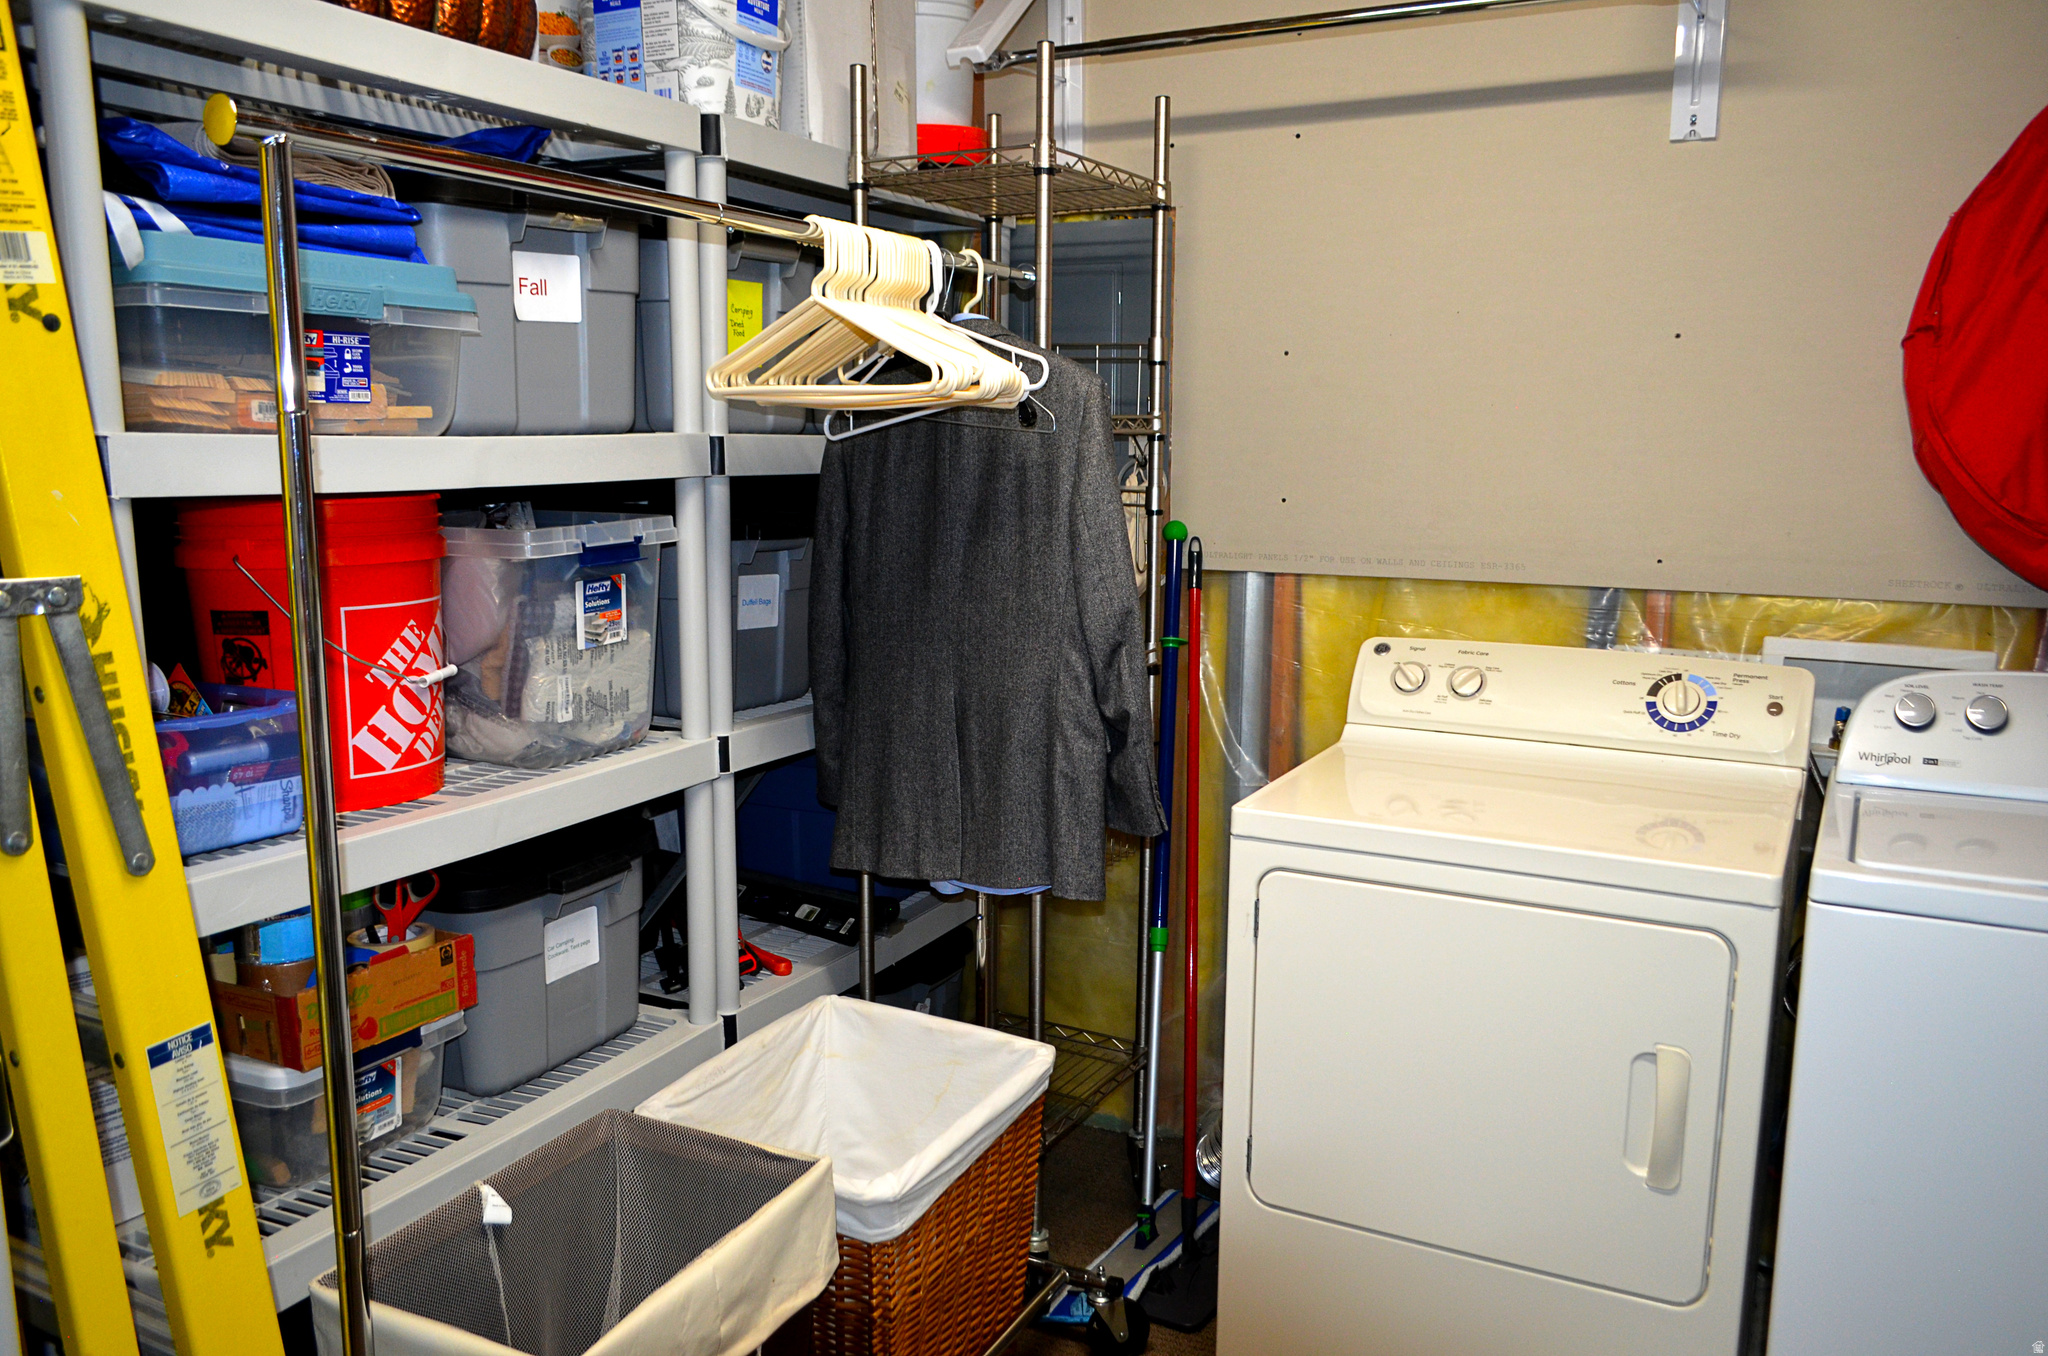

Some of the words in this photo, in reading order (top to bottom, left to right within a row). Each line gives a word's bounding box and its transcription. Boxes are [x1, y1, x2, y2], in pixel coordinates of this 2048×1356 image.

[519, 277, 547, 296] Fall
[310, 288, 368, 311] Hefty
[332, 335, 360, 345] HI-RISE
[1204, 551, 1253, 560] ULTRALIGHT
[1258, 553, 1289, 561] PANELS
[1294, 554, 1314, 562] 1/2"
[1319, 555, 1335, 563] FOR
[1340, 556, 1356, 564] USE
[1360, 557, 1372, 565] ON
[1376, 558, 1404, 566] WALLS
[1409, 559, 1425, 567] AND
[1430, 560, 1475, 569] CEILINGS
[1480, 562, 1526, 571] ESR-3365
[587, 583, 610, 593] Hefty
[1888, 579, 1951, 590] SHEETROCK
[585, 599, 610, 608] Solutions
[365, 619, 426, 690] THE
[352, 606, 443, 772] HOM
[1728, 732, 1741, 740] Dry
[1858, 751, 1911, 766] Whirlpool
[460, 950, 469, 977] Trade
[461, 981, 469, 997] Fair
[167, 1032, 193, 1051] NOTICE
[172, 1043, 193, 1060] AVISO
[355, 1087, 383, 1104] olutions
